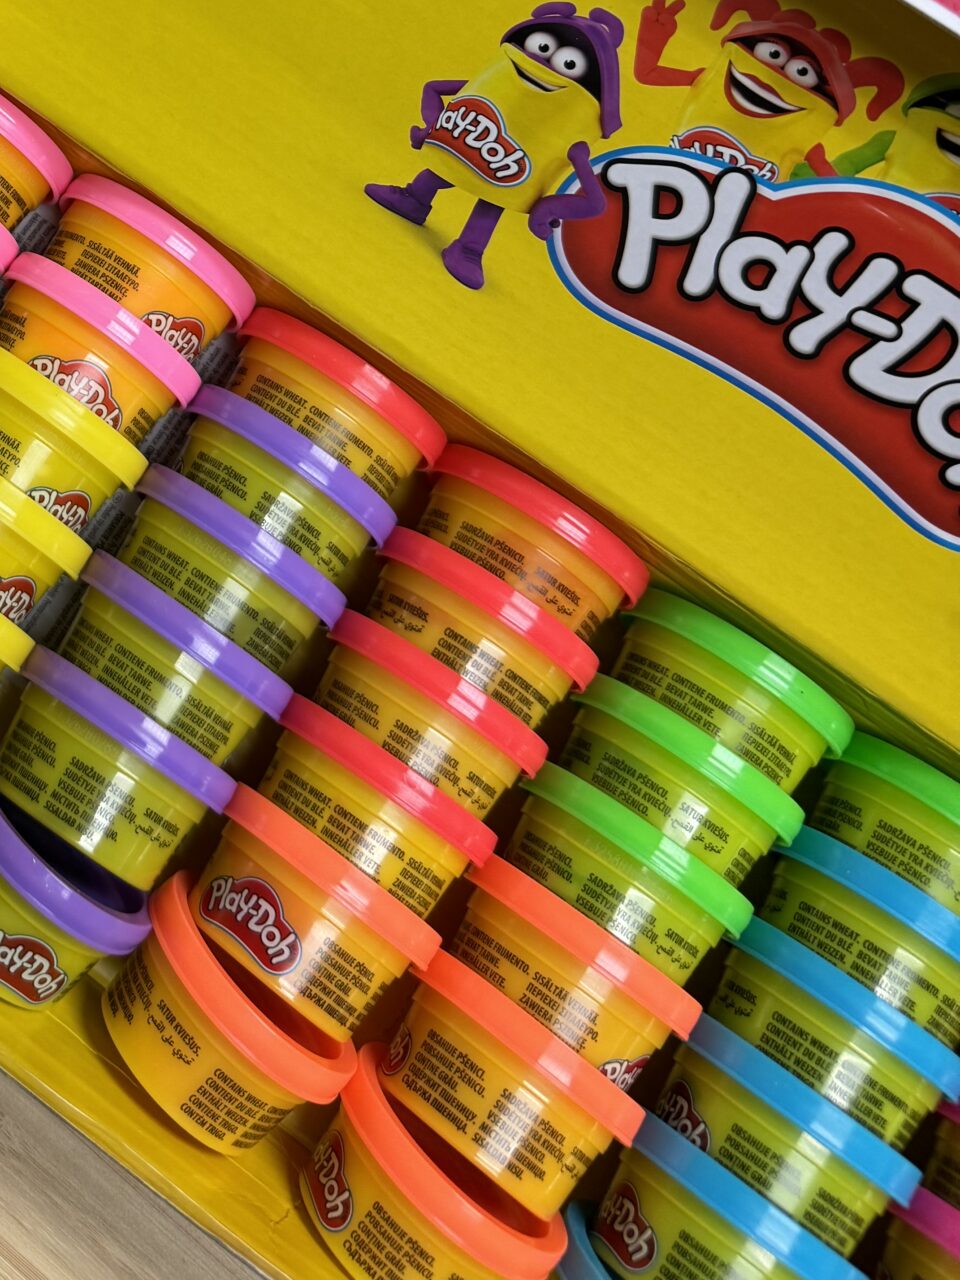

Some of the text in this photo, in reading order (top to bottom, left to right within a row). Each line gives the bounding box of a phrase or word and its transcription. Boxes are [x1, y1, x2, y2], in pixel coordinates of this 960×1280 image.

[603, 158, 960, 489] Play-Do
[208, 877, 293, 964] Play-Doh
[157, 999, 201, 1057] SATUR KVIEŠUS.
[372, 1201, 436, 1267] OBSAHUJE PŠENICI.
